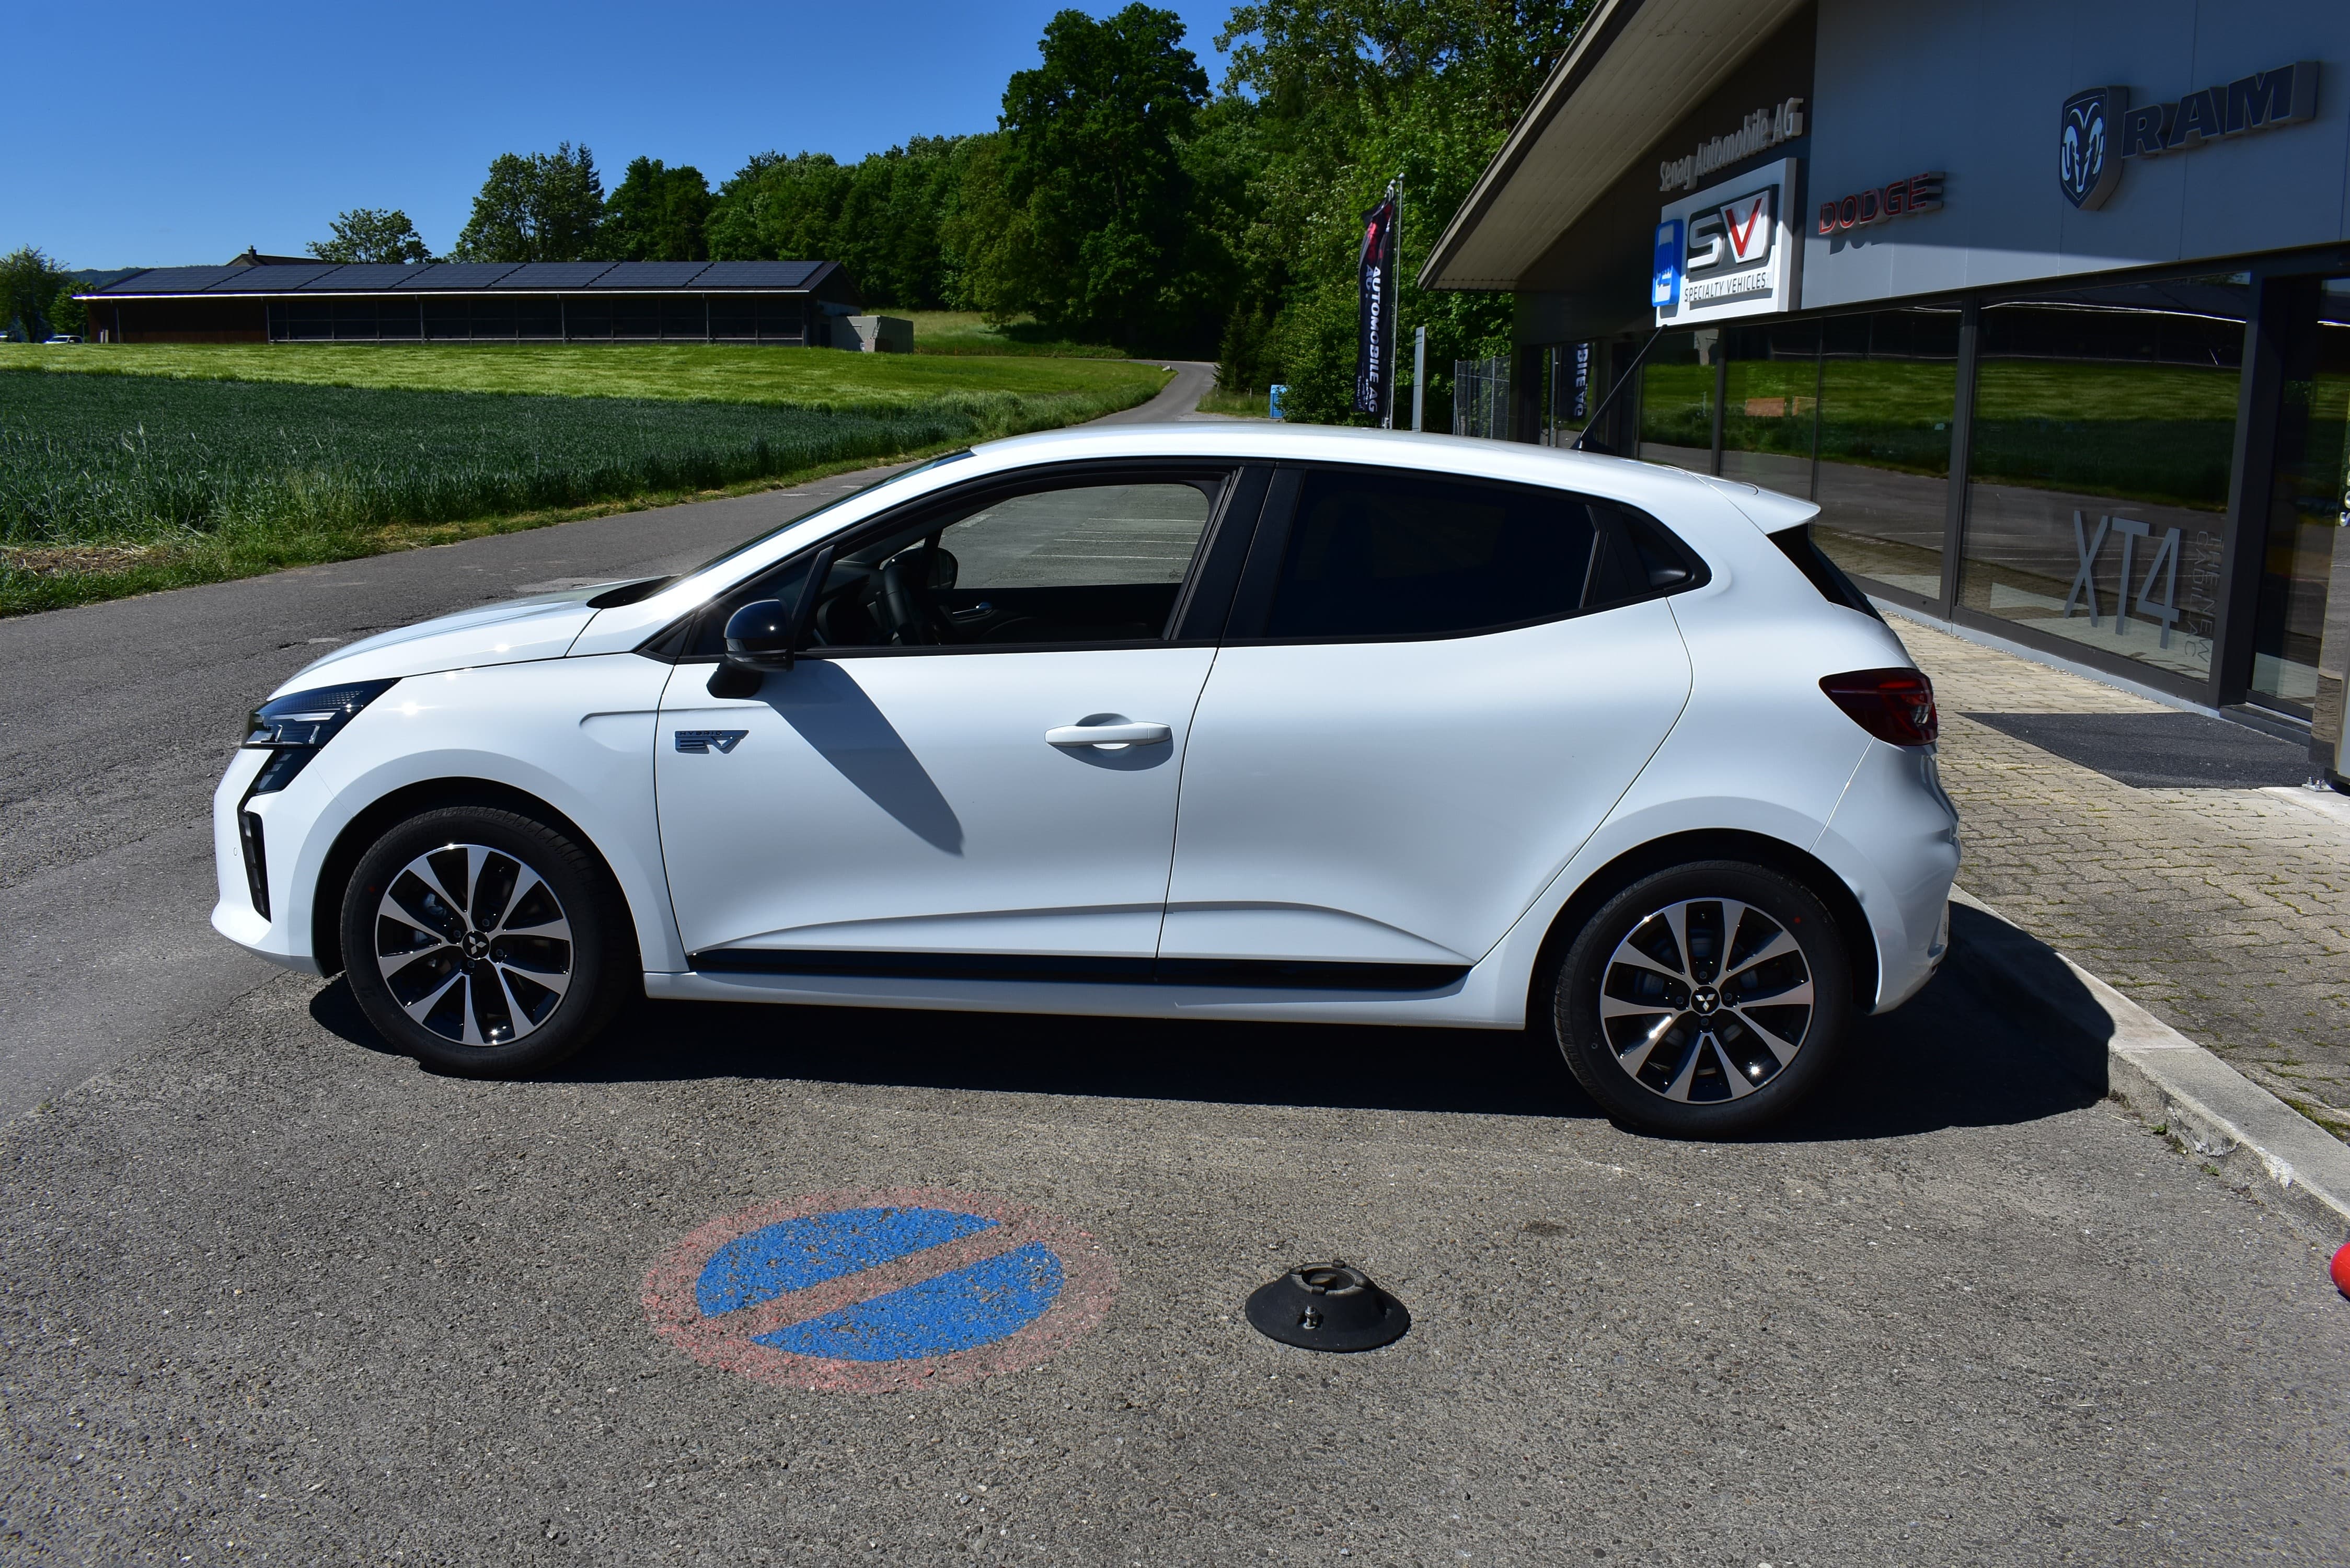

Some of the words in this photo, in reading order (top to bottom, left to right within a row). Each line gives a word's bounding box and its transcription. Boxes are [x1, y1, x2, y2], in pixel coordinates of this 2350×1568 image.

[1660, 155, 1694, 191] Senag
[1695, 109, 1771, 176] Automobile
[1772, 97, 1803, 142] AG
[2122, 61, 2300, 158] RAM
[1688, 190, 1769, 269] SV
[1819, 172, 1934, 235] DODGE
[1369, 266, 1381, 383] AUTOMOBILE
[1685, 281, 1724, 302] SPECIALTY
[1726, 272, 1766, 294] VEHICLES
[1369, 386, 1378, 412] AG
[2064, 510, 2182, 649] XT4
[2184, 531, 2209, 657] CADILLAC
[2205, 532, 2222, 586] THE
[2197, 596, 2217, 663] NEW
